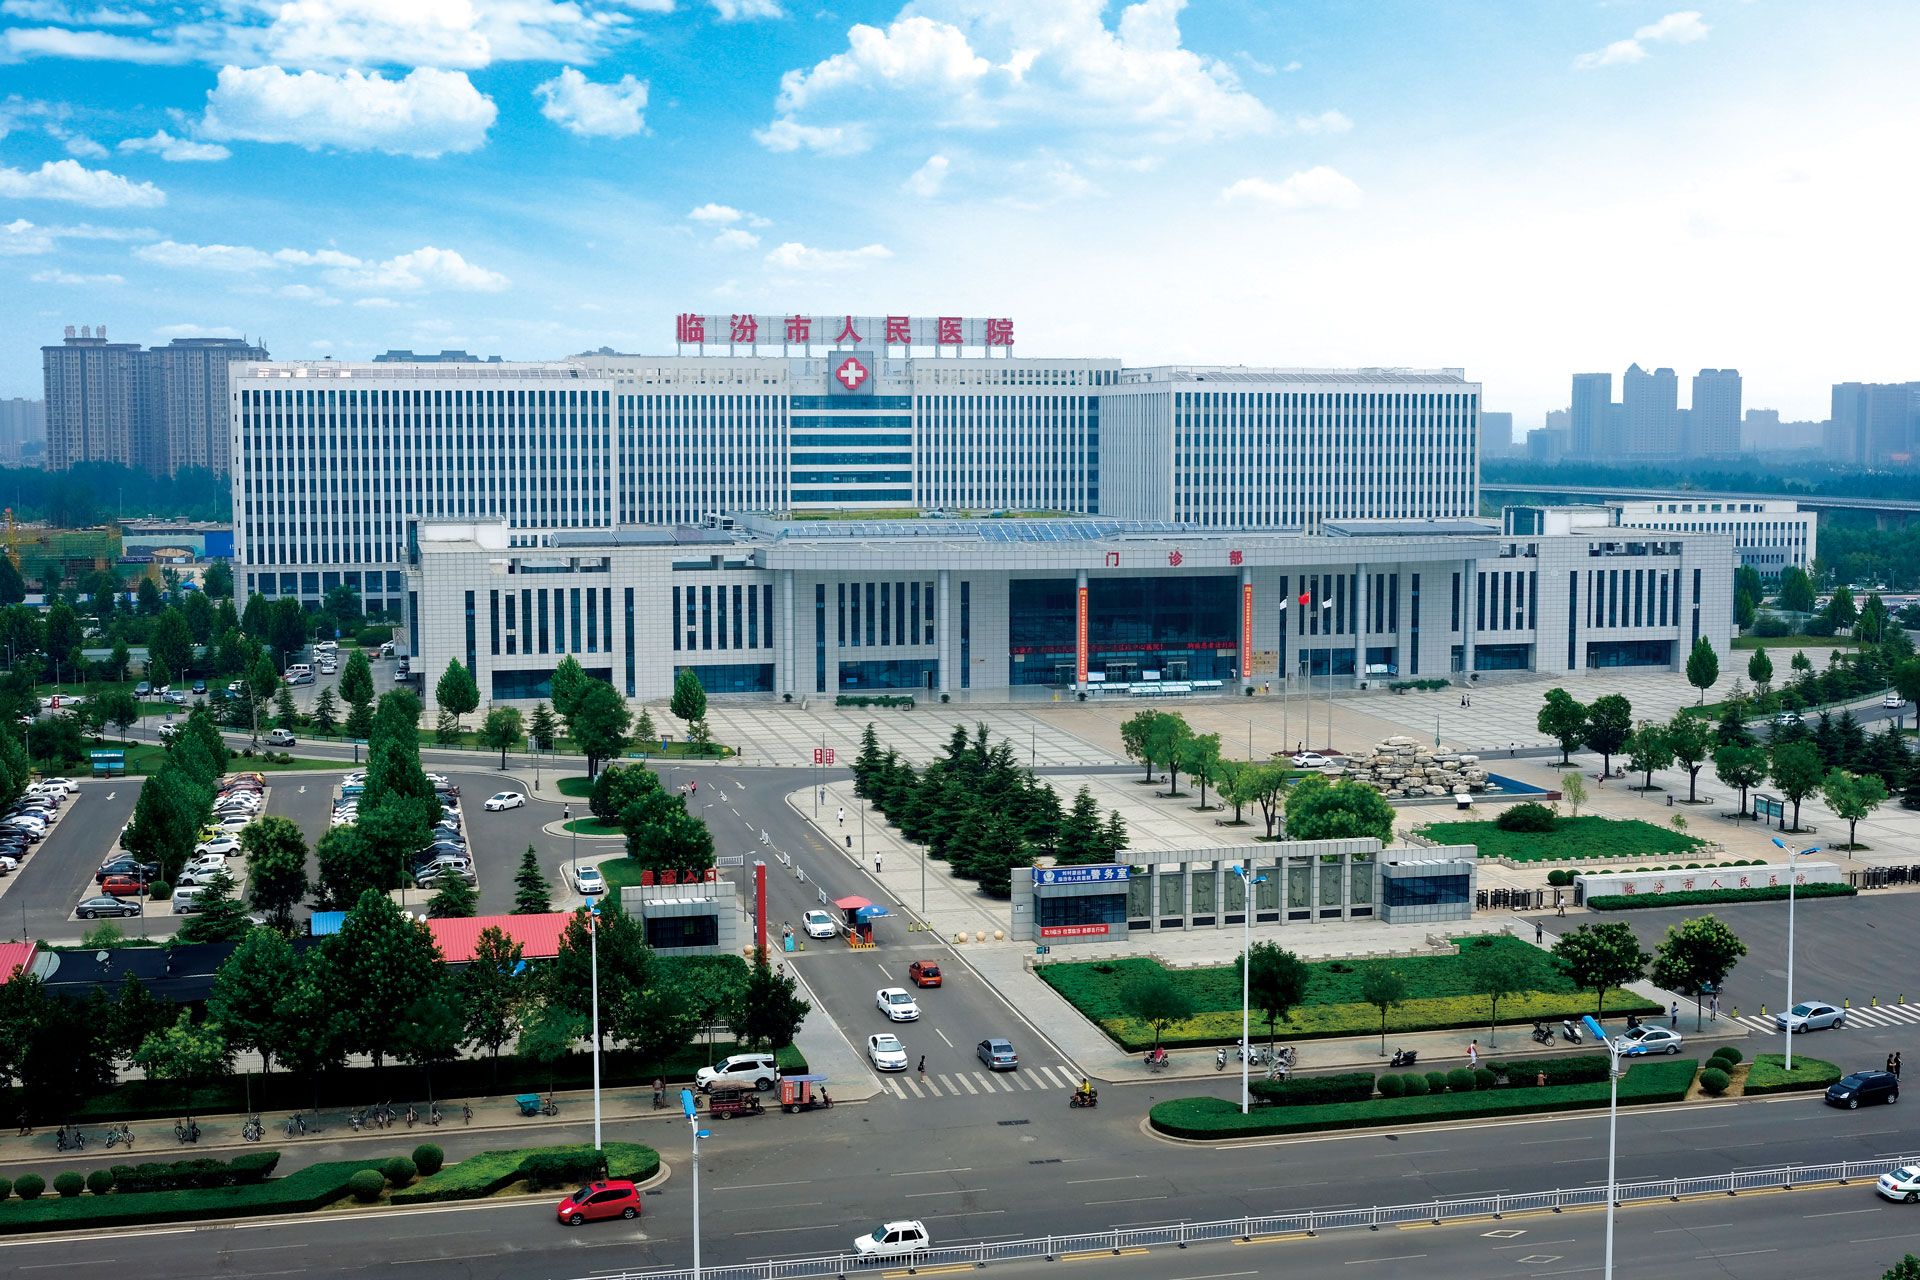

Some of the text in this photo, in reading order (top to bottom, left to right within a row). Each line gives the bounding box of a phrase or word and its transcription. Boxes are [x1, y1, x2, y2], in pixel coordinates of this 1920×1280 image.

[677, 313, 1015, 346] 临汾市人民医院
[1105, 550, 1244, 567] 门诊部
[1091, 868, 1127, 880] 警务室
[1624, 873, 1806, 895] 临汾市人民医院
